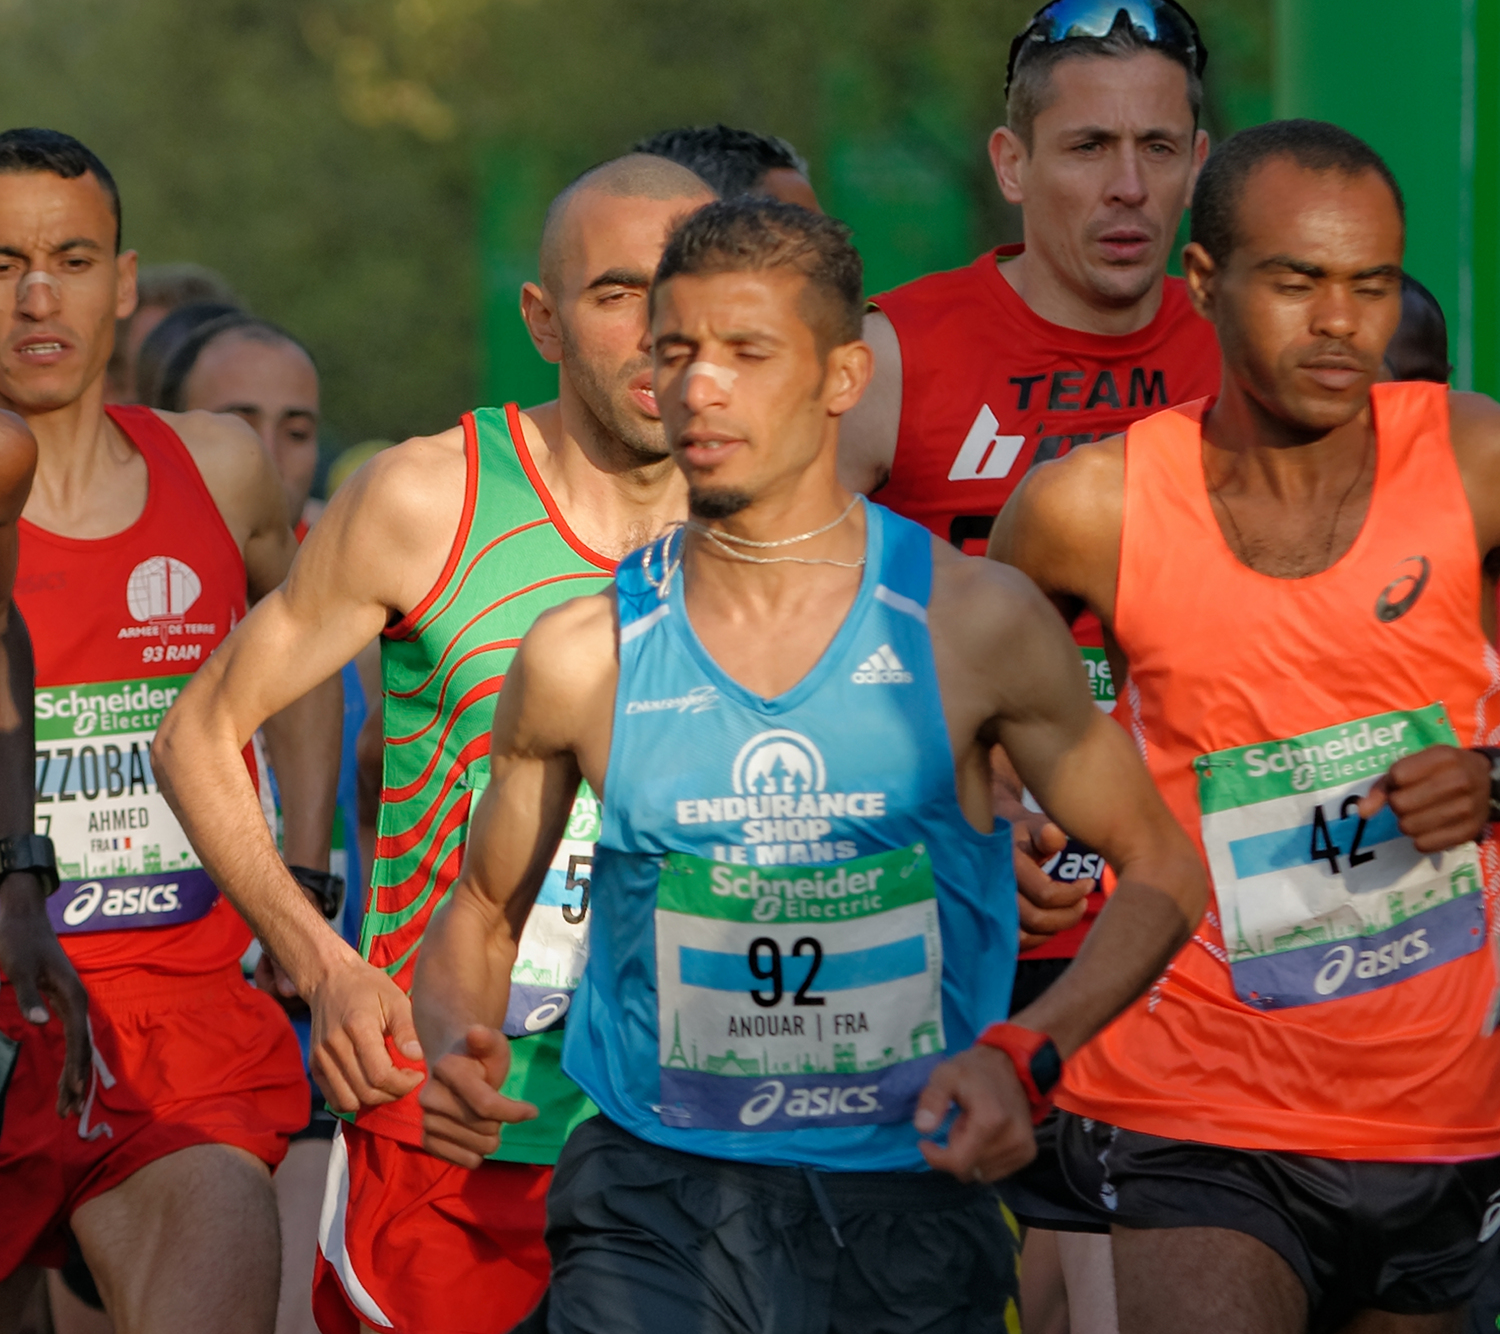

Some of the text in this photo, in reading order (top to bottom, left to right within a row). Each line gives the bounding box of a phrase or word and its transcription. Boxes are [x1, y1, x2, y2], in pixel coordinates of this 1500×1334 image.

[1008, 367, 1168, 411] TEAM
[142, 644, 202, 662] 93 RAM
[851, 668, 913, 684] adidas
[35, 683, 179, 719] Schneider
[100, 710, 166, 731] Electr
[1243, 720, 1409, 777] Schneider
[88, 807, 149, 833] AHMED
[677, 793, 886, 825] ENDURANCE
[91, 838, 110, 852] FRA
[742, 819, 832, 844] SHOP
[1310, 794, 1376, 875] 42
[714, 840, 858, 865] LE MANS
[710, 866, 885, 900] Schneider
[102, 883, 179, 916] asics
[784, 894, 883, 919] Electric
[1355, 929, 1430, 979] asics
[748, 936, 827, 1008] 92
[728, 1012, 869, 1038] ANOUAR FRA
[784, 1085, 880, 1118] asics
